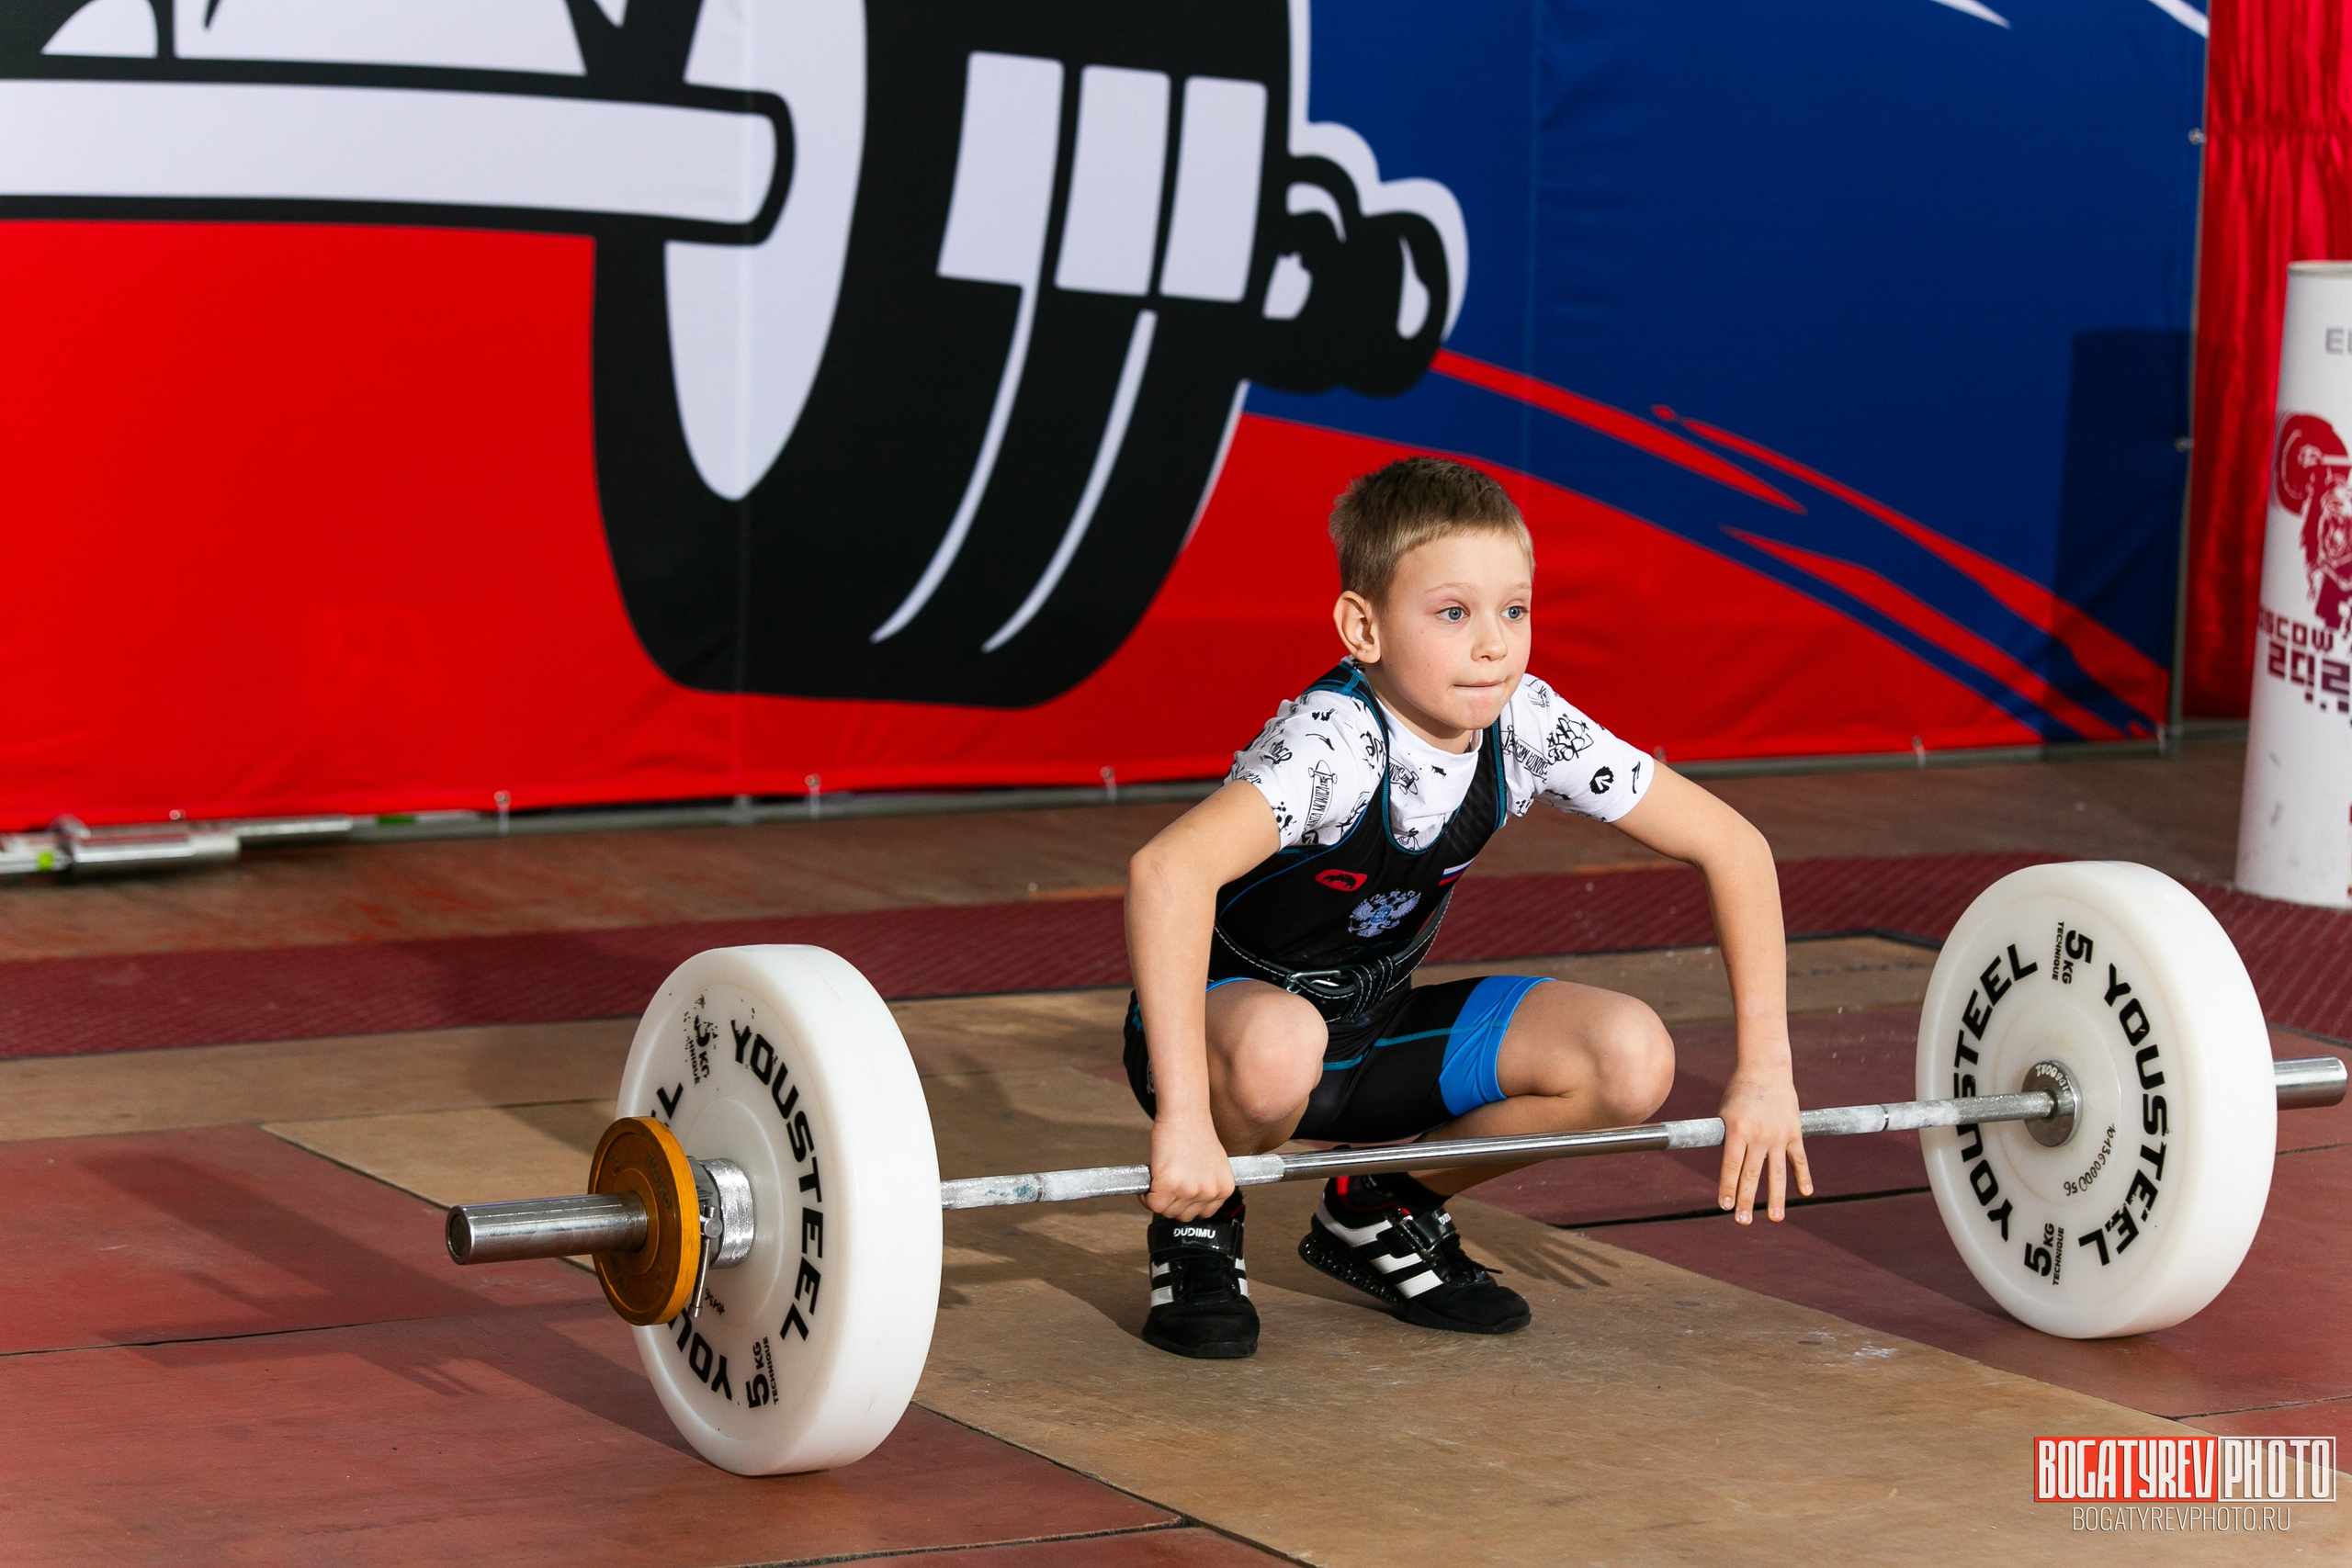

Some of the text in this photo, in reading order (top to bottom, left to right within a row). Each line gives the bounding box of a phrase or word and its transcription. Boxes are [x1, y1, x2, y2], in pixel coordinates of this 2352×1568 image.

[2052, 921, 2064, 981] TECHNIQUE
[2078, 963, 2168, 1267] YOUSTEEL
[730, 1019, 824, 1342] YOUSTEEL
[1173, 1227, 1216, 1239] DUDIMU
[2052, 1226, 2065, 1286] TECHNIQUE
[763, 1337, 779, 1404] TECHNIQUE
